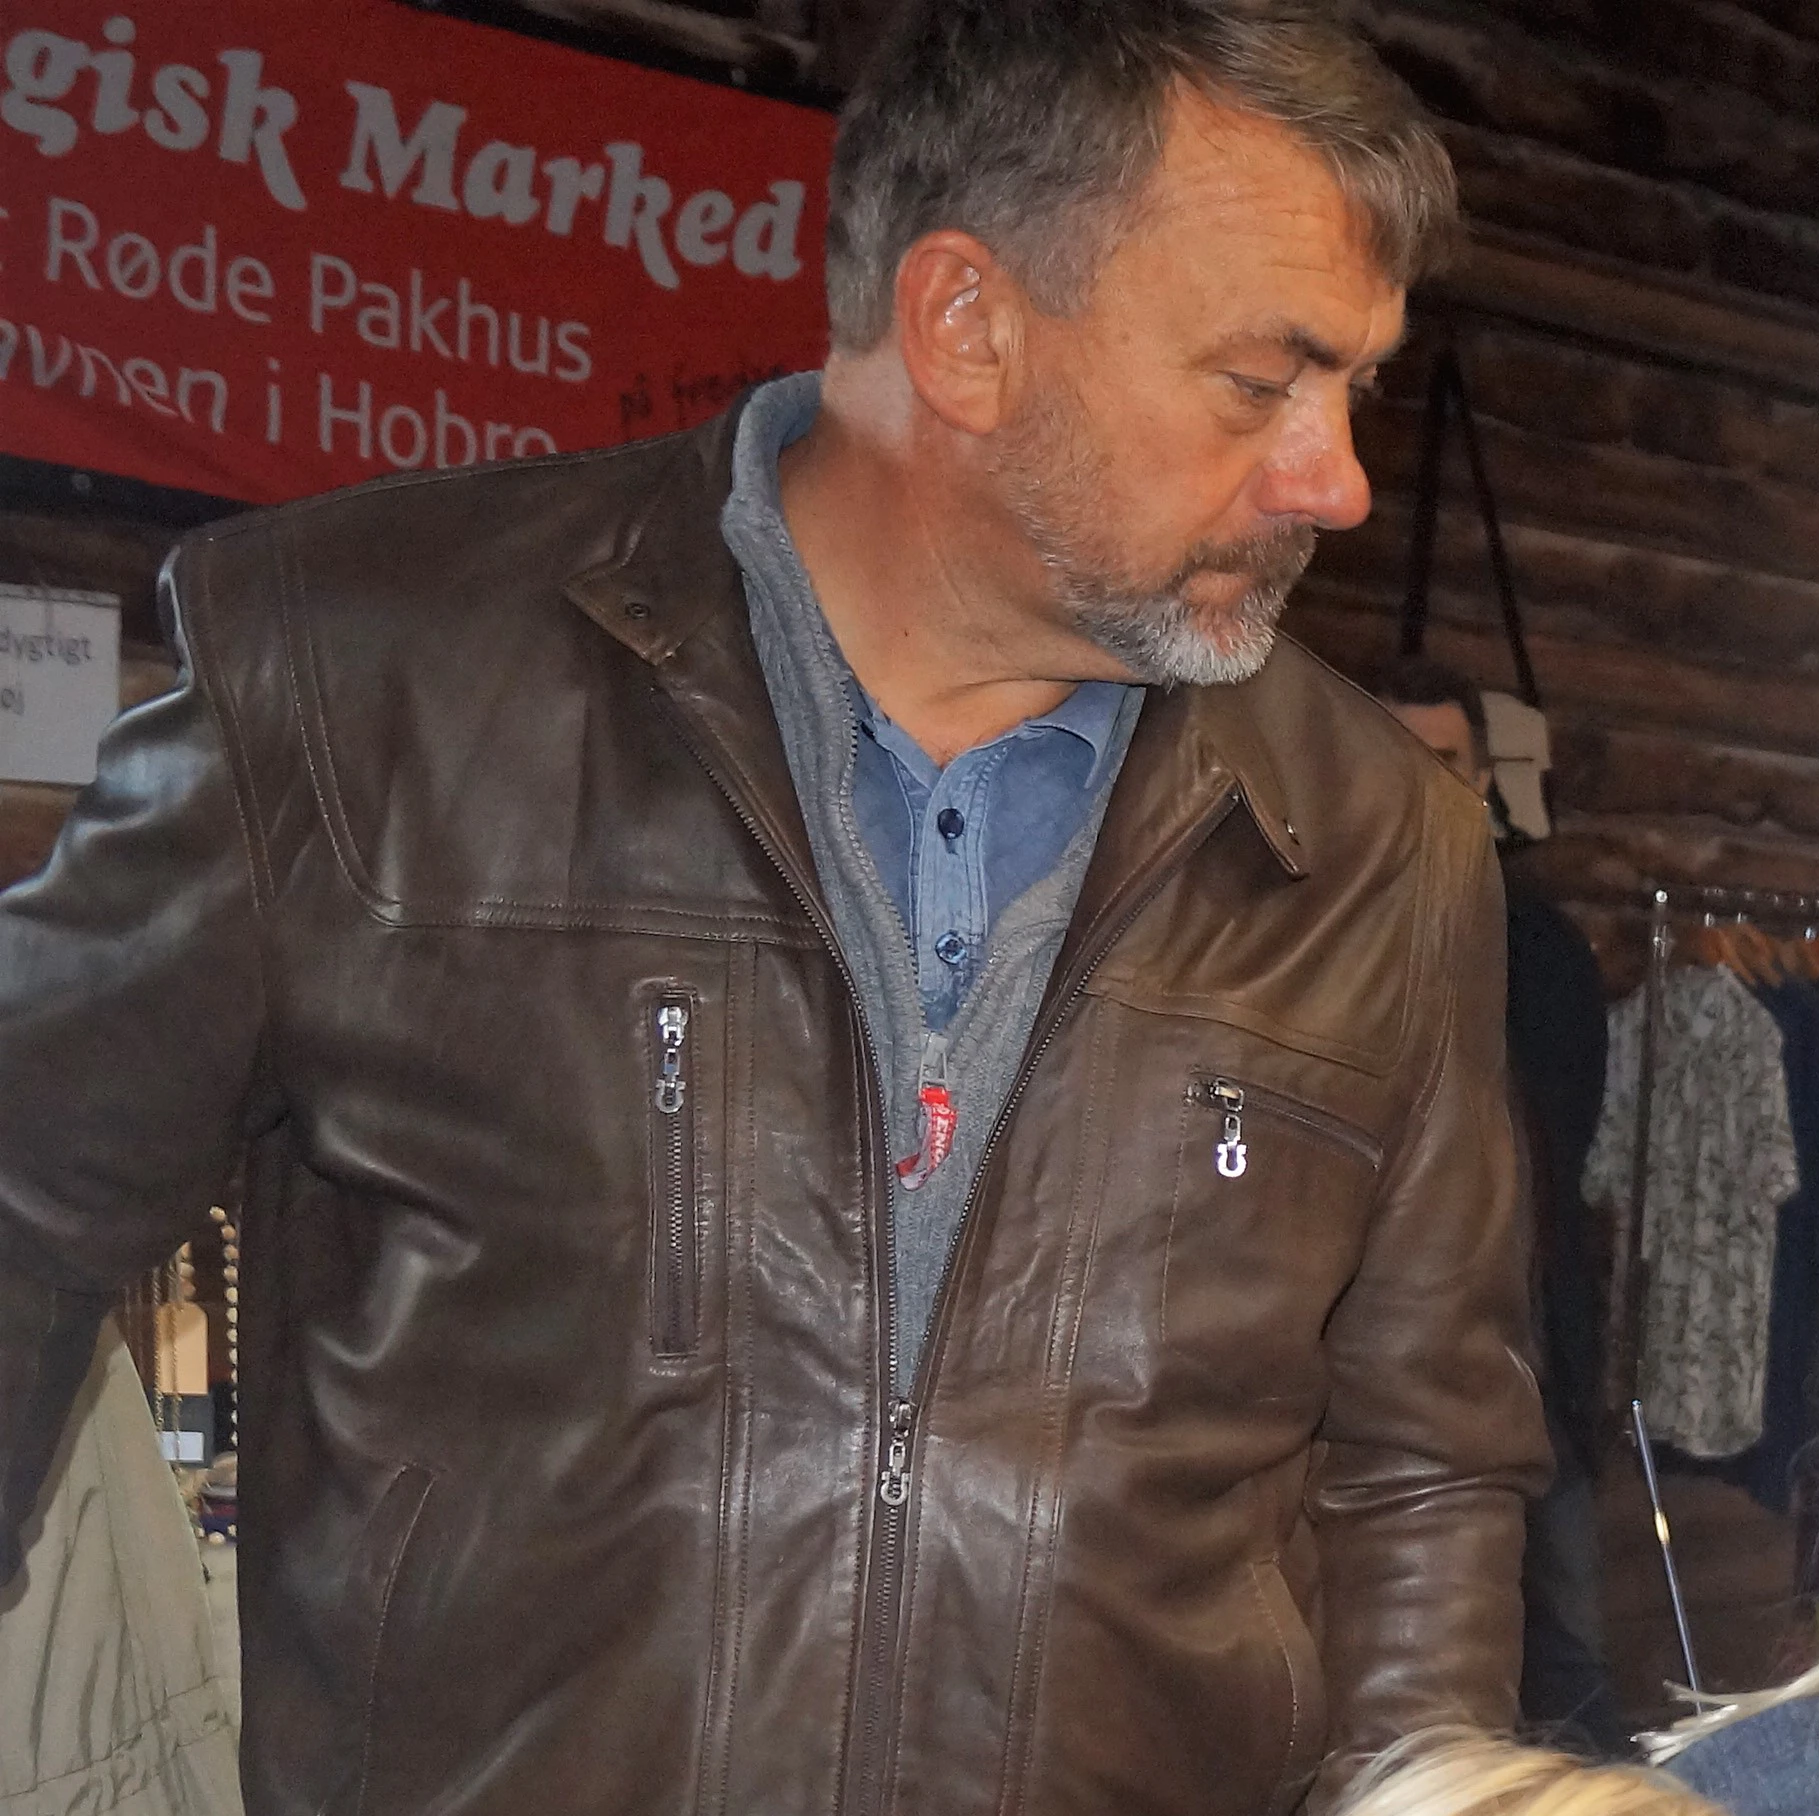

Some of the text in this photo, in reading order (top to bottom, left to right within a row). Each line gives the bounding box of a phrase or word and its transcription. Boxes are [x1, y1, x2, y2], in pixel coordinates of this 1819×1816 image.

[2, 17, 804, 290] gisk Marked
[45, 197, 593, 382] Røde Pakhus
[266, 357, 282, 443] i
[319, 372, 556, 469] Hobro
